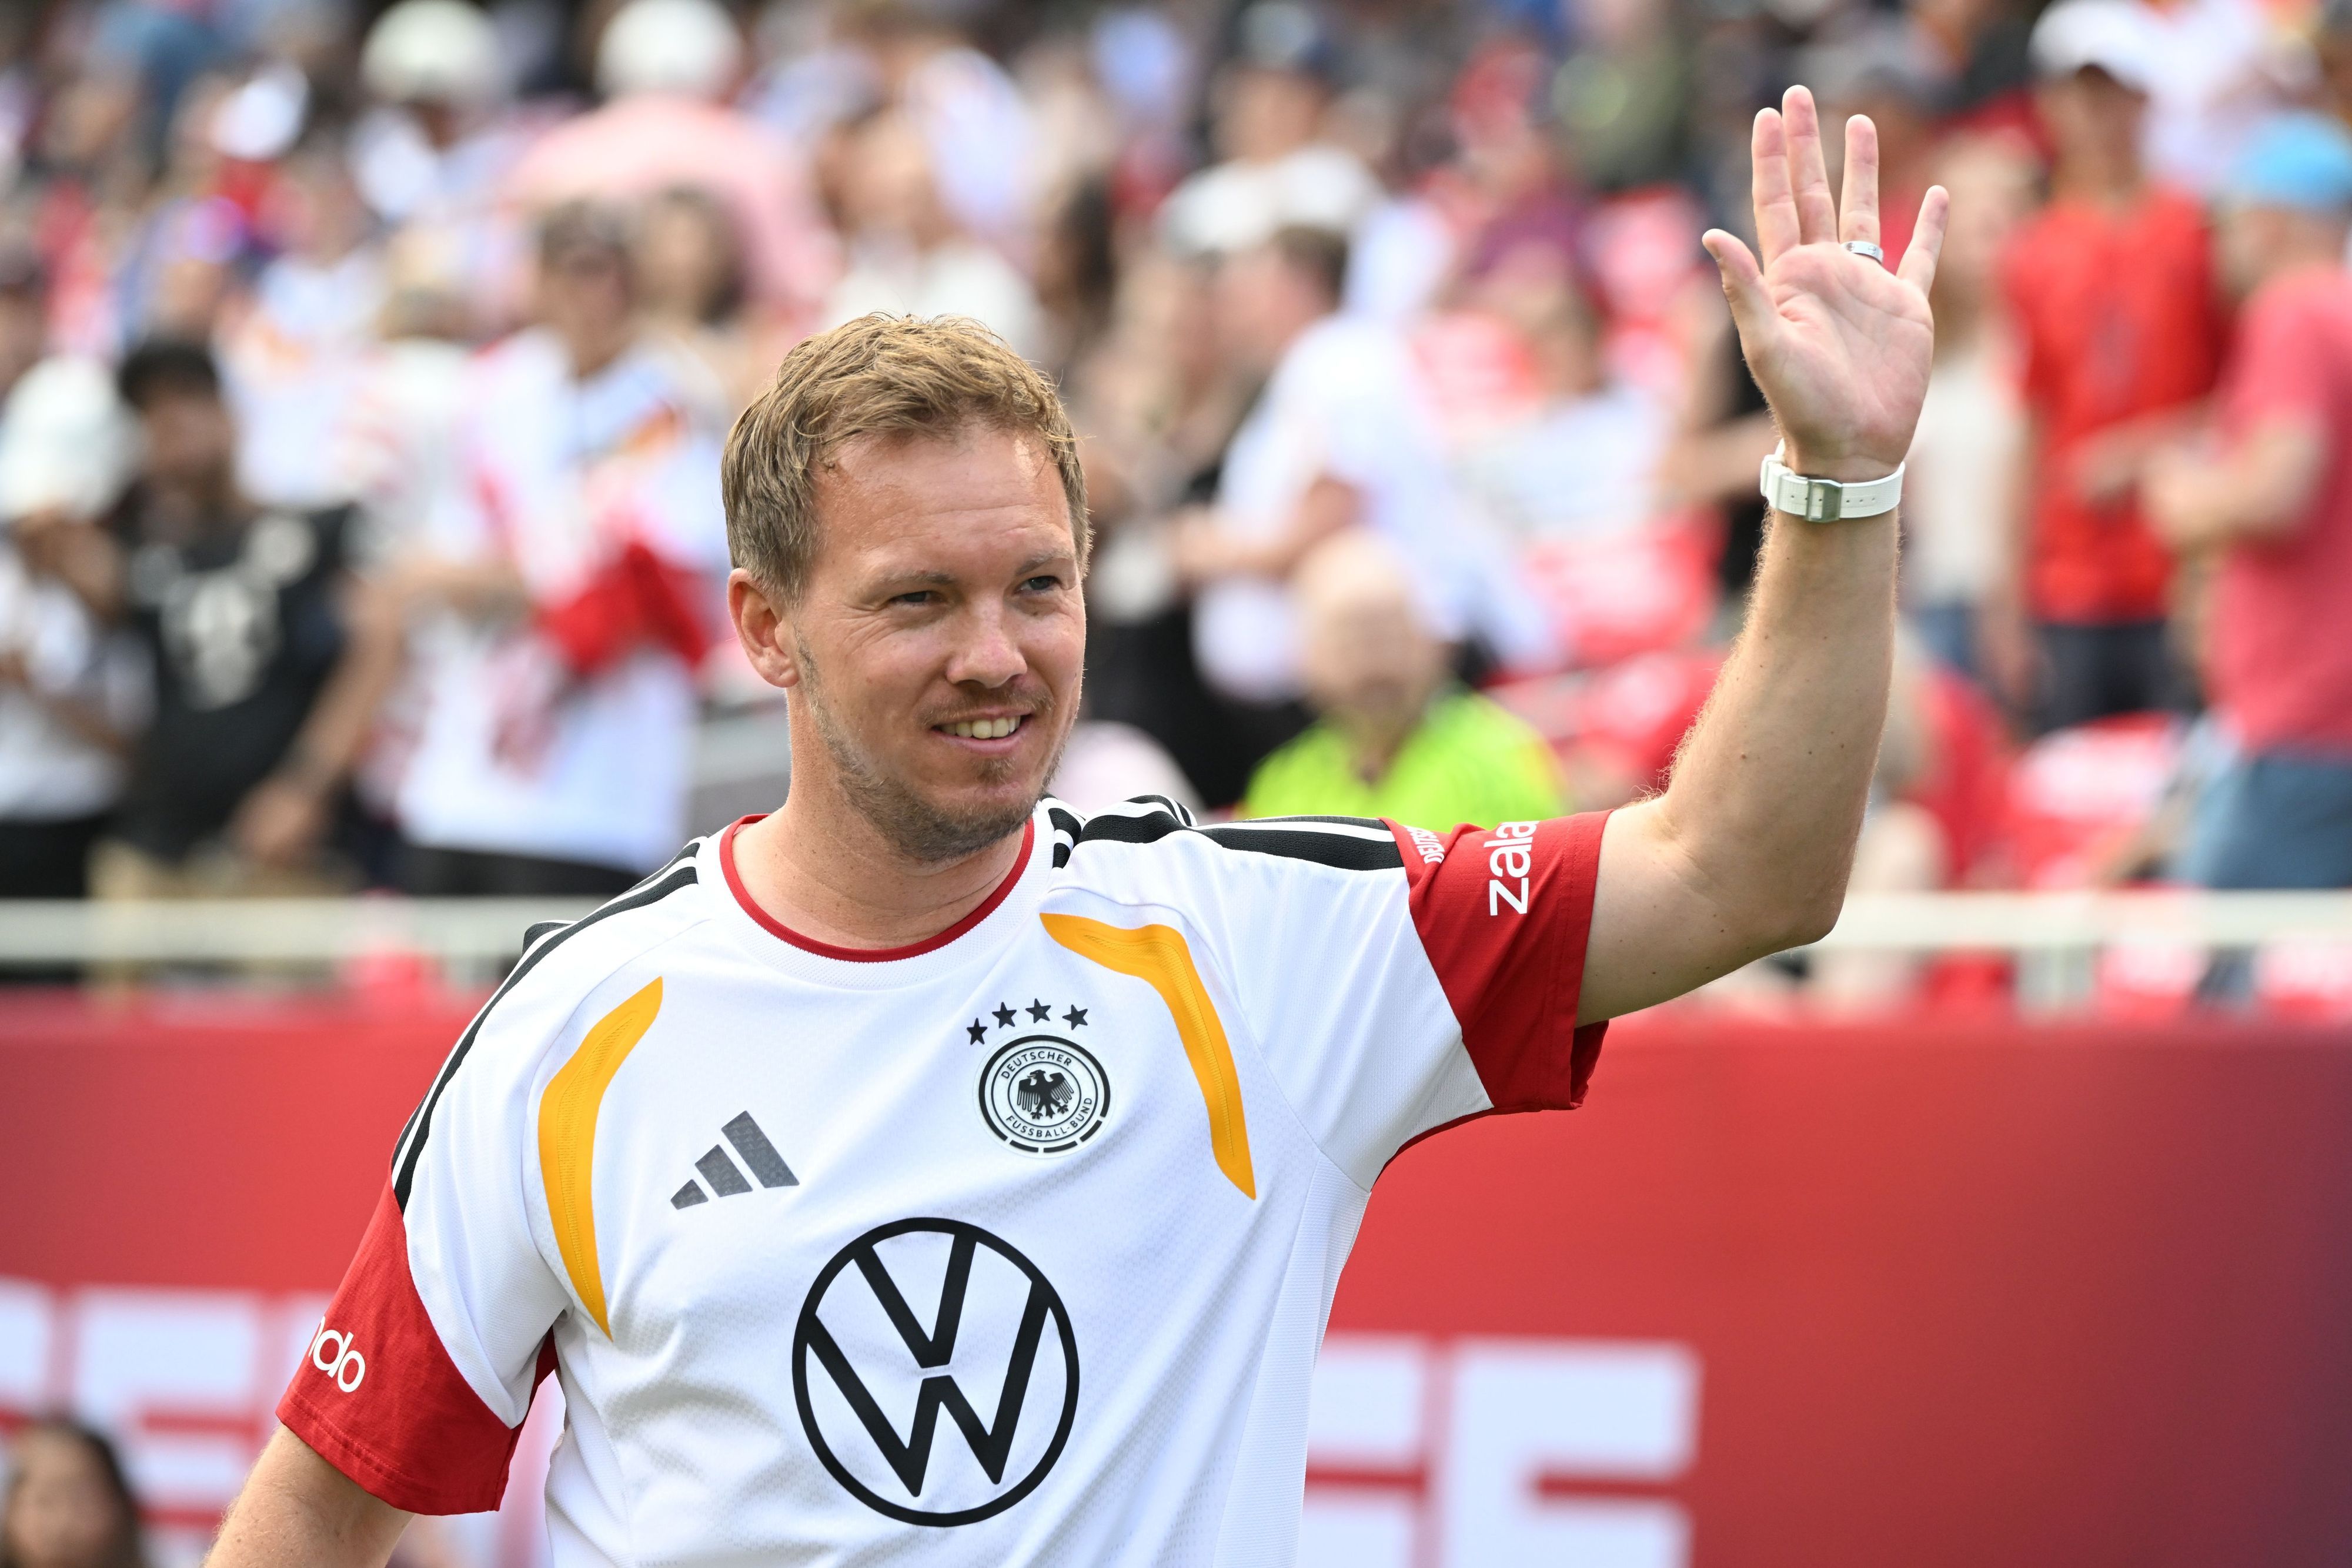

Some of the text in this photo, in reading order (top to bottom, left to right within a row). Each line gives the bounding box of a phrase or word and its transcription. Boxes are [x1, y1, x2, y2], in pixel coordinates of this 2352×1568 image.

[1001, 1051, 1072, 1079] DEUTSCHER
[1005, 1098, 1093, 1138] FUSSBALL-BUND
[795, 1223, 1064, 1499] VW
